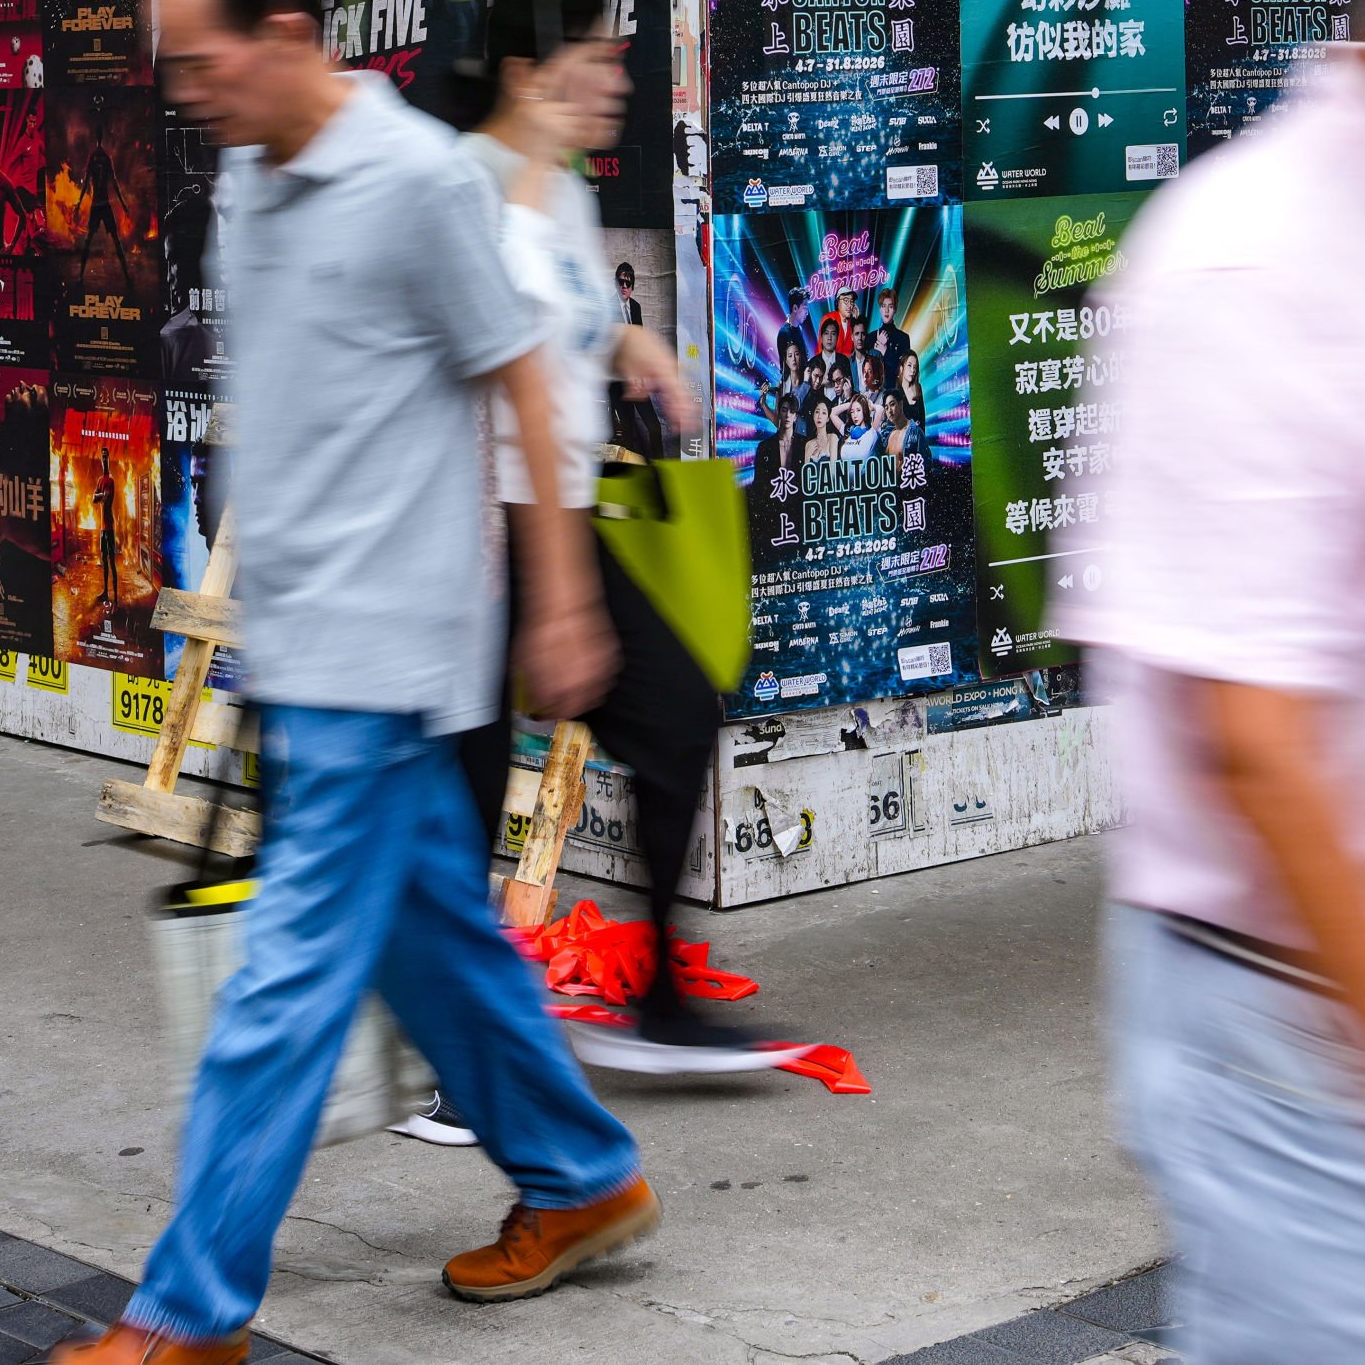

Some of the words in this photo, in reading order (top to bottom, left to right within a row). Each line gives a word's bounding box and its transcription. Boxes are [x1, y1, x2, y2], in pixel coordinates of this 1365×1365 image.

[77, 5, 116, 19] PLAY
[62, 17, 134, 32] FOREVER
[793, 10, 886, 54] BEATS
[1251, 6, 1329, 44] BEATS
[1007, 19, 1146, 62] 彷似我的家
[825, 55, 885, 71] 31.8.2026
[782, 80, 820, 92] Cantopop
[821, 79, 831, 90] DJ
[908, 67, 936, 92] 272
[584, 157, 620, 178] TIDES
[770, 187, 791, 196] WATER
[792, 185, 814, 195] WORLD
[1050, 212, 1106, 249] Beat
[85, 294, 124, 308] PLAY
[69, 306, 141, 321] FOREVER
[801, 456, 897, 496] CANTON
[803, 492, 897, 543] BEATS
[121, 690, 164, 725] 9178
